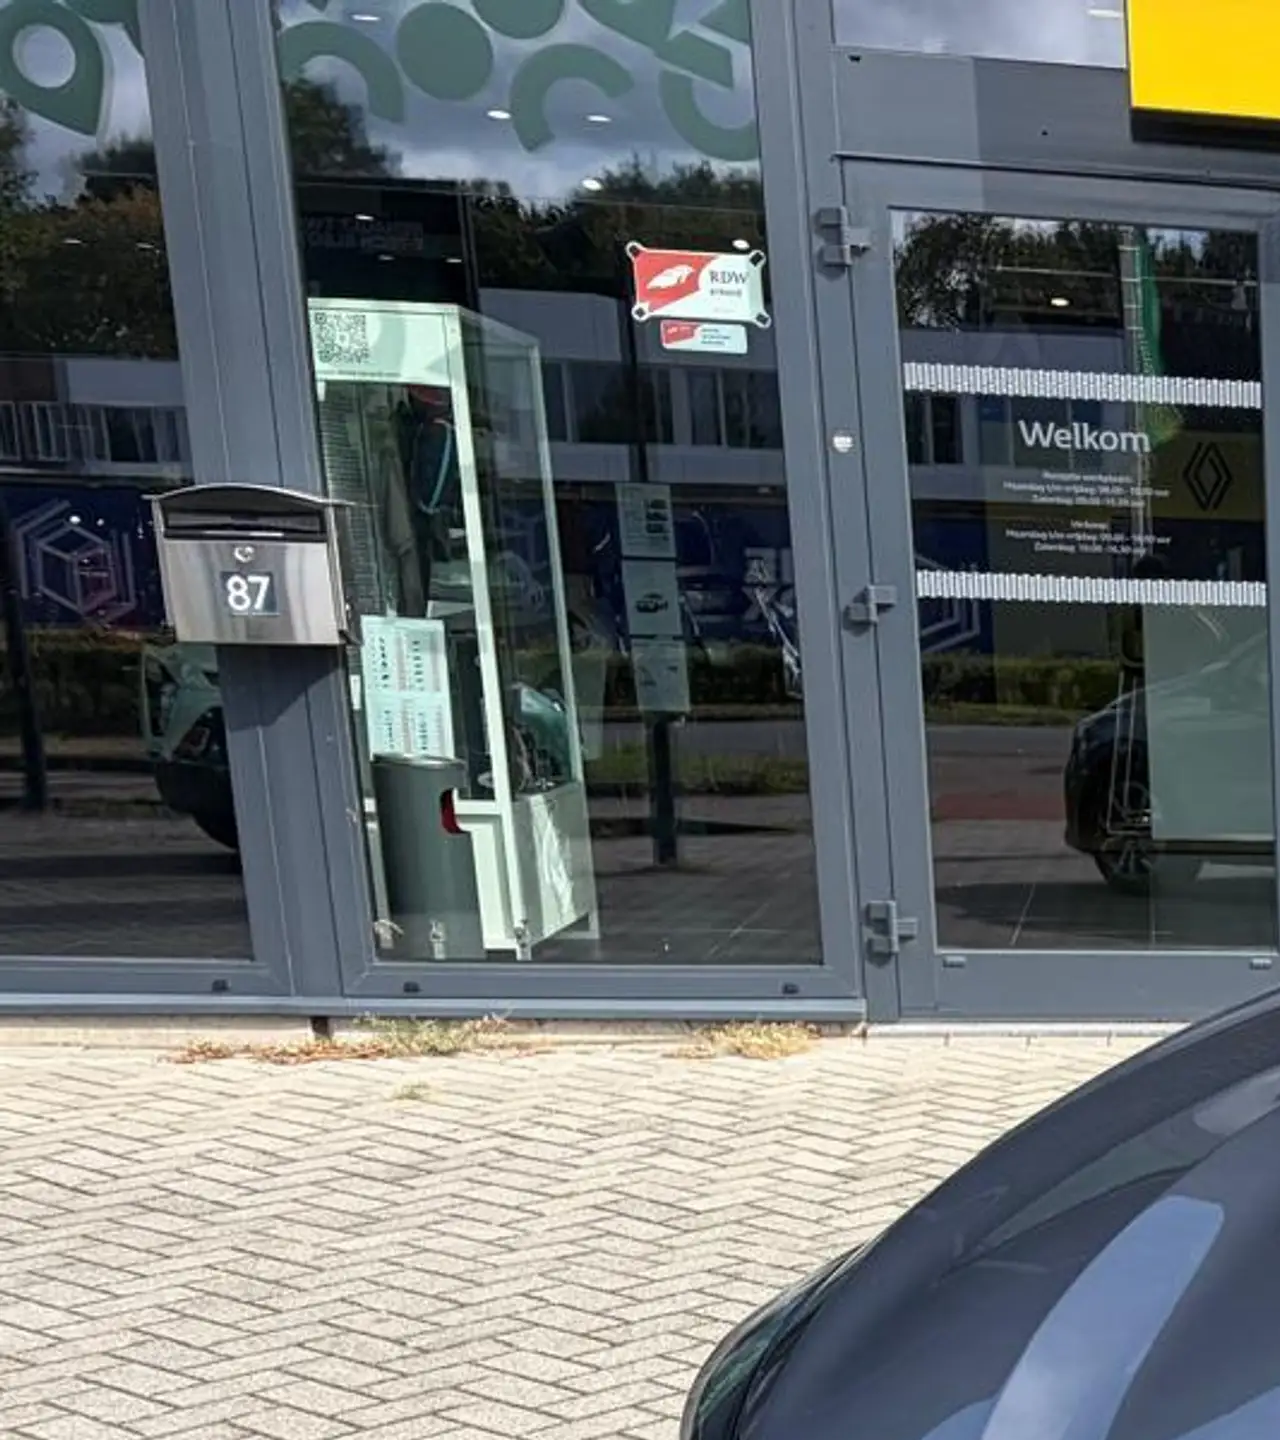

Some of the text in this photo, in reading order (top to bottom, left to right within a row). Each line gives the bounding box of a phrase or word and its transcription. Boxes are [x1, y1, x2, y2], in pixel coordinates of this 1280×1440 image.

[709, 270, 749, 285] RDW
[1018, 420, 1152, 453] Welkom
[227, 574, 270, 611] 87
